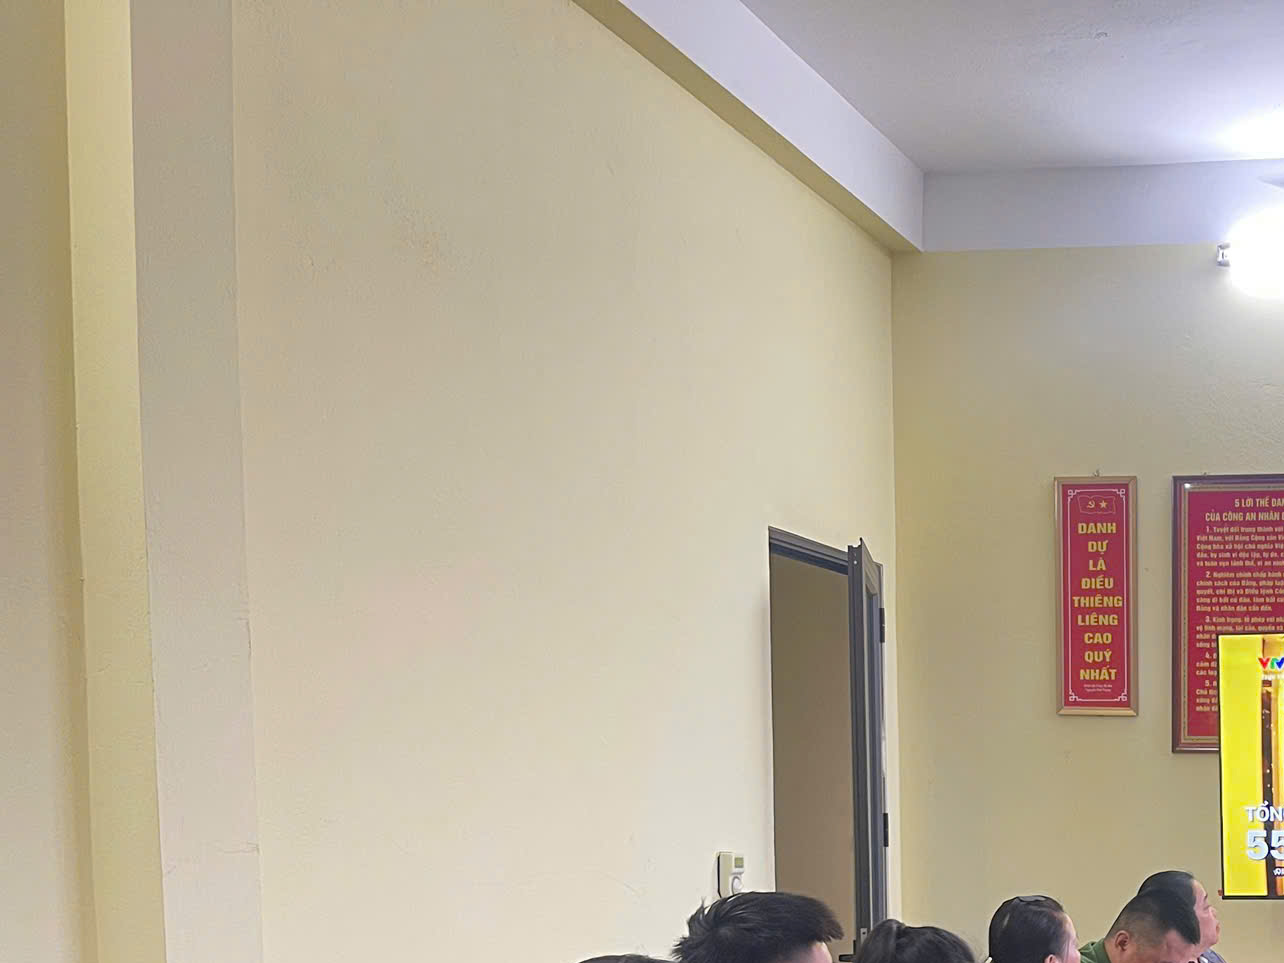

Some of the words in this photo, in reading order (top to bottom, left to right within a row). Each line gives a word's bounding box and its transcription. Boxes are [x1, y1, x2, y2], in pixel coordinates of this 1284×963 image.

[1205, 508, 1221, 522] CỦA
[1222, 510, 1244, 522] CÔNG
[1245, 511, 1257, 521] AN
[1258, 510, 1280, 522] NHÂN
[1077, 522, 1117, 534] DANH
[1087, 539, 1109, 555] DỰ
[1088, 556, 1107, 571] LÀ
[1080, 574, 1114, 590] ĐIỀU
[1072, 594, 1123, 608] THIÊNG
[1077, 612, 1119, 626] LIÊNG
[1083, 632, 1112, 644] CAO
[1084, 649, 1113, 663] QUÝ
[1079, 664, 1117, 681] NHẤT
